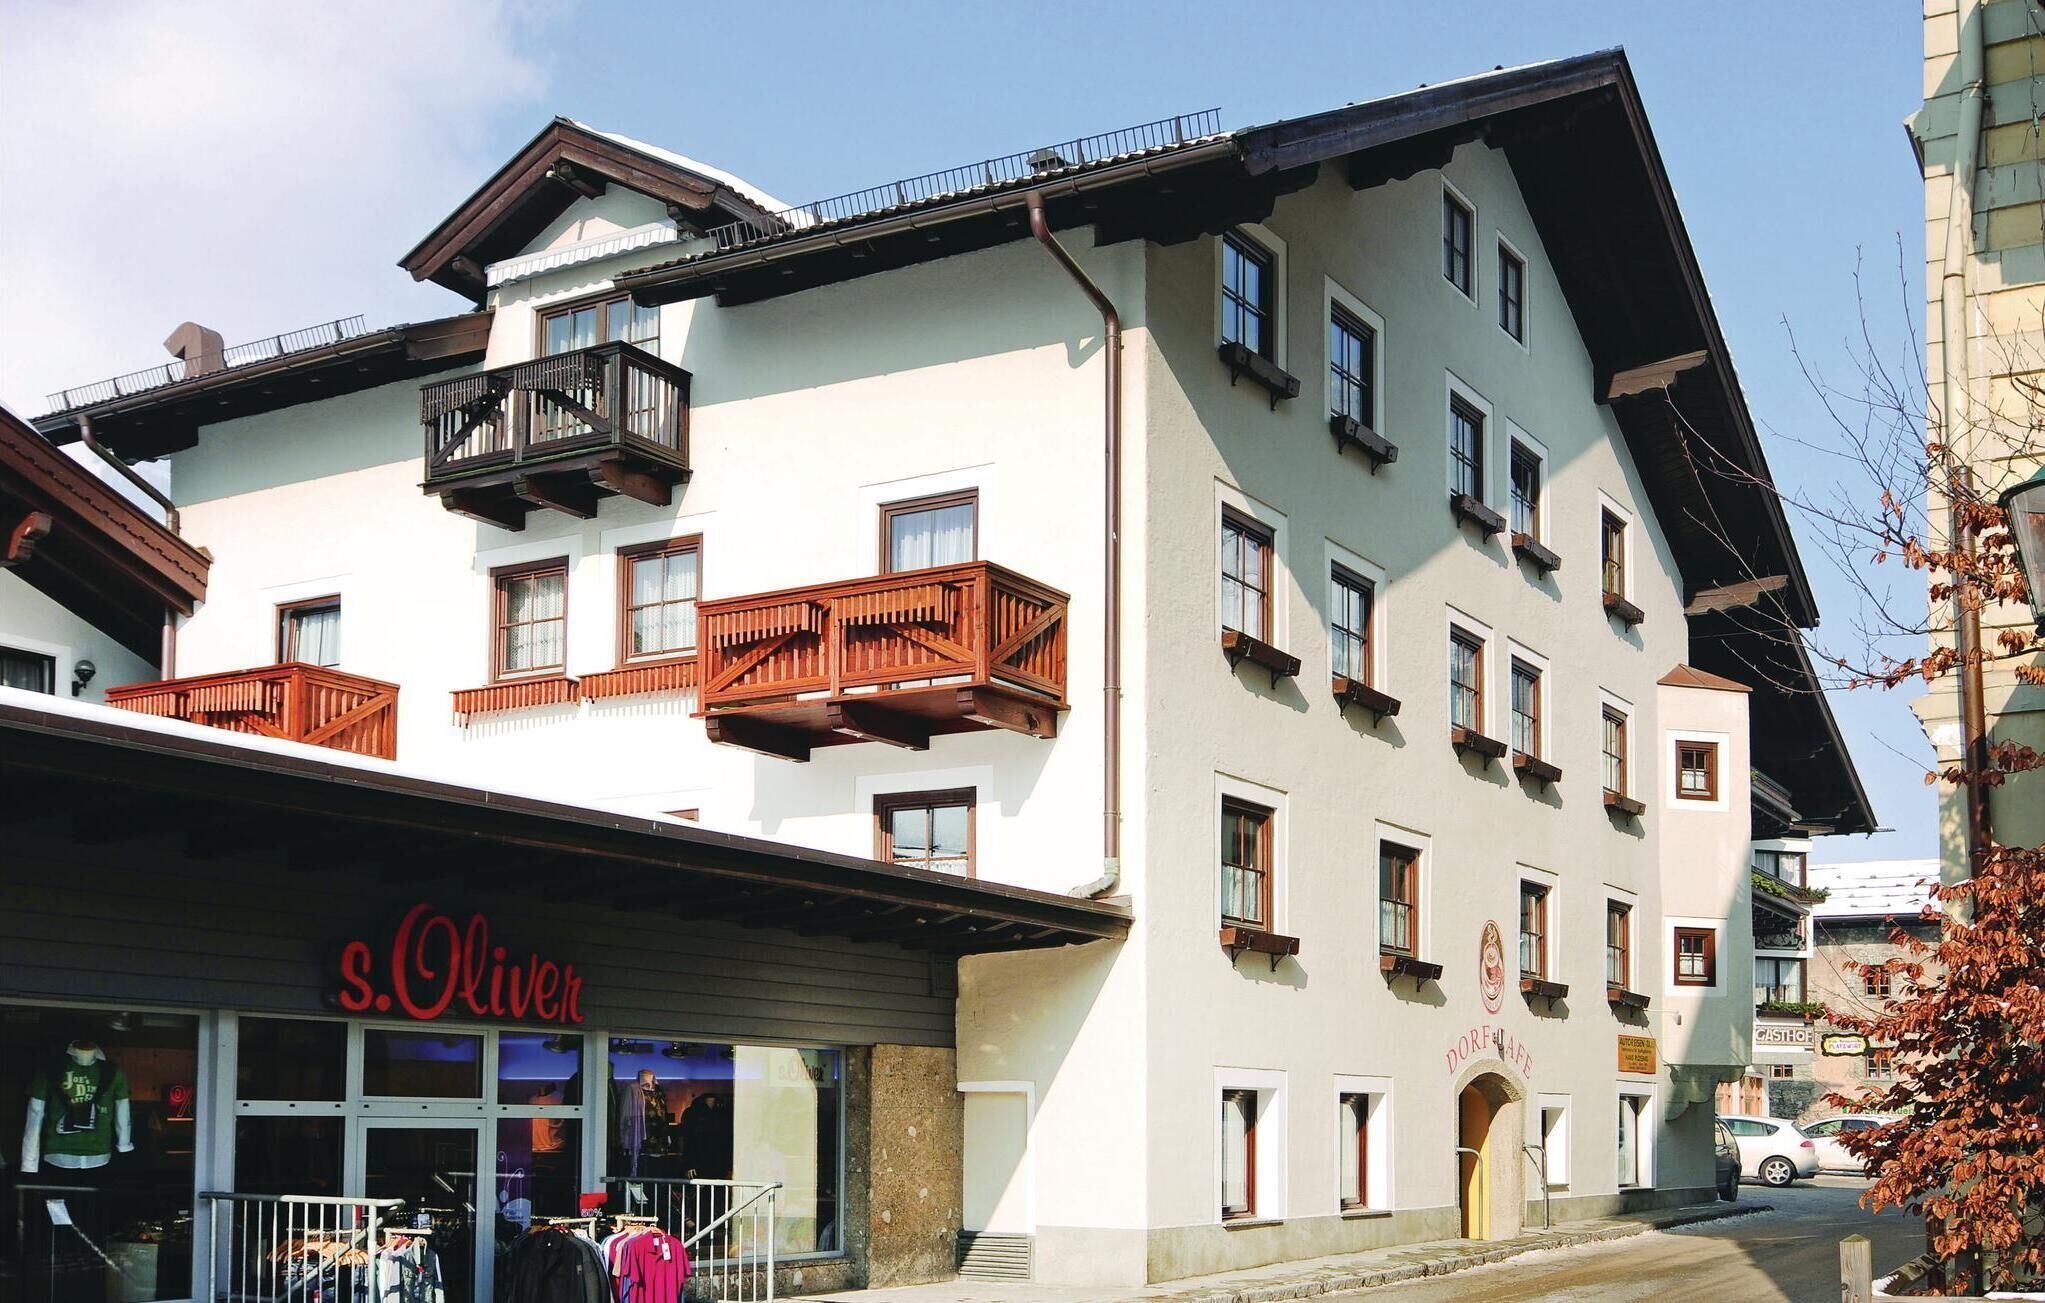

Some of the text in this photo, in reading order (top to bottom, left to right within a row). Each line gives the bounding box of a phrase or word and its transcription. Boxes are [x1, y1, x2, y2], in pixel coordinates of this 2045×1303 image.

[339, 902, 585, 1024] s.Oliver
[1446, 1025, 1533, 1080] DORF AFE
[1756, 1028, 1814, 1043] GASTHOF
